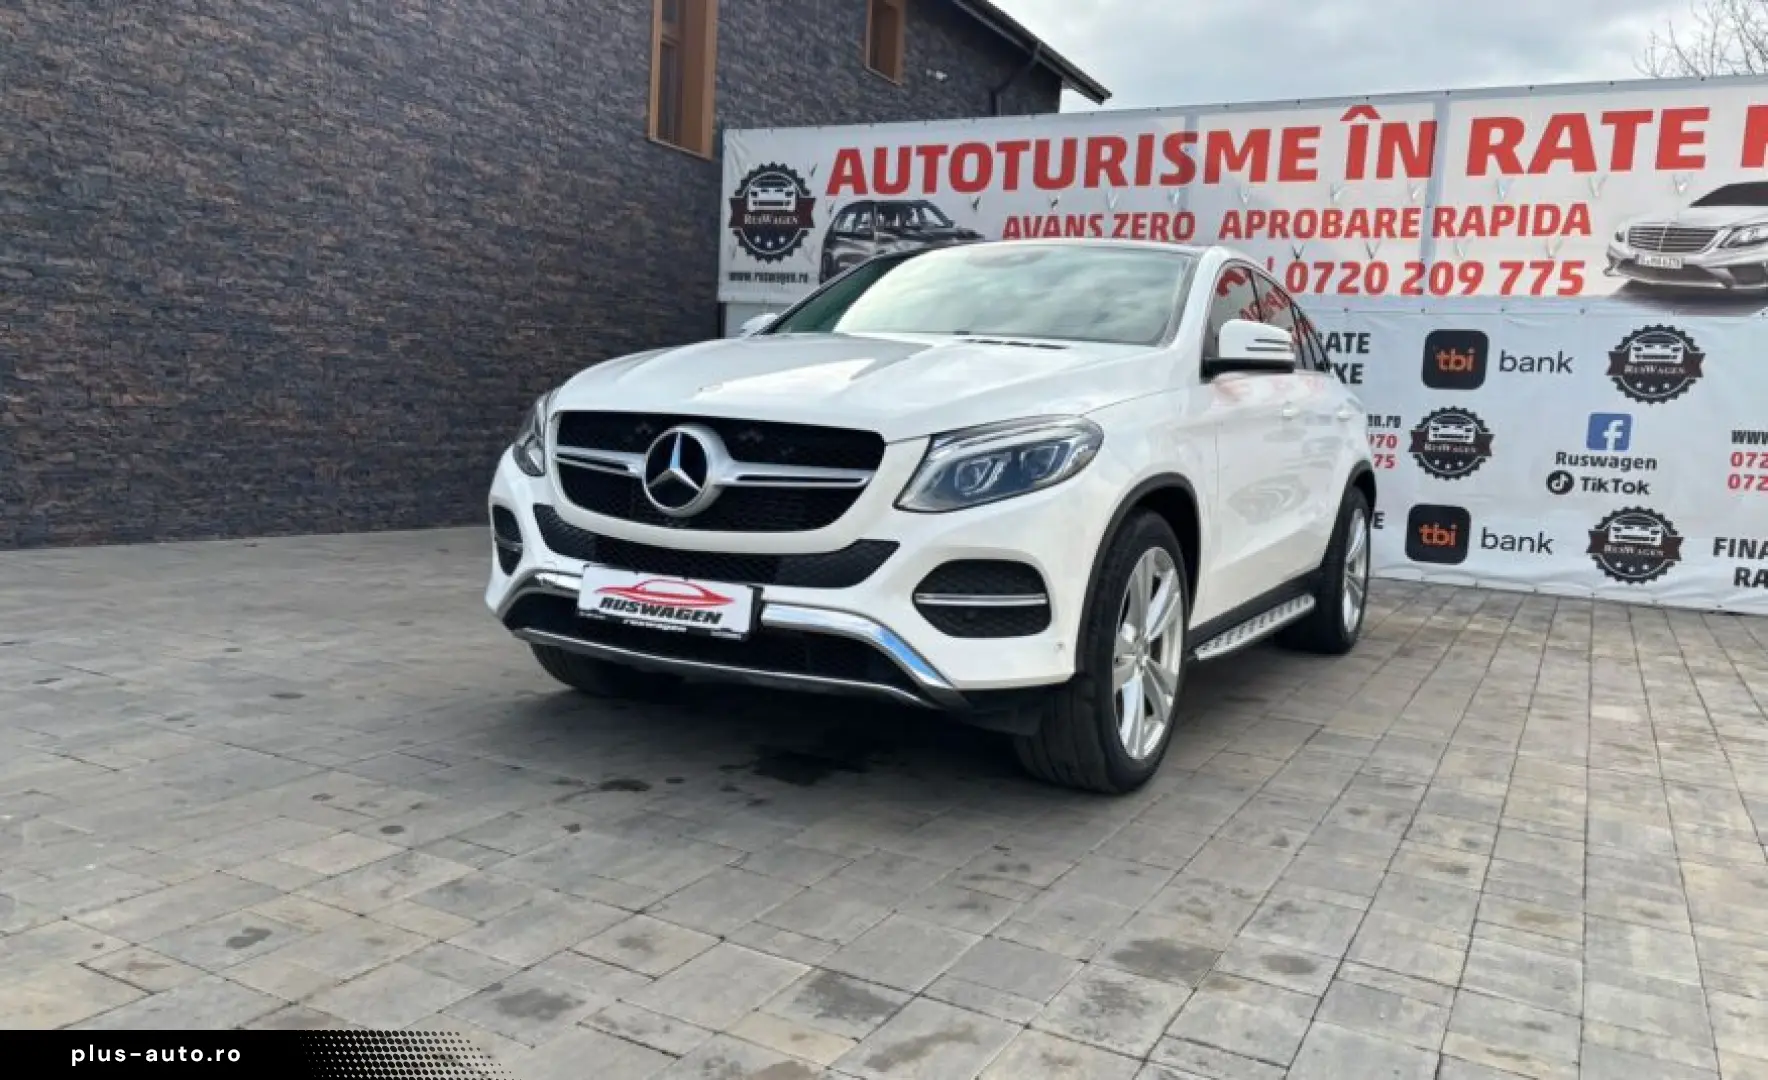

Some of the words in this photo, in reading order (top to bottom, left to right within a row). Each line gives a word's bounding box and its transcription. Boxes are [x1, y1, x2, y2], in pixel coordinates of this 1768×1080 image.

[826, 127, 1320, 195] AUTOTURISME
[1340, 104, 1437, 179] ÎN
[1466, 108, 1710, 177] RATE
[1003, 212, 1104, 240] AVANS
[1111, 210, 1196, 241] ZERO
[1218, 207, 1421, 239] APROBARE
[1432, 203, 1592, 238] RAPIDA
[1285, 261, 1390, 293] 0720
[1400, 262, 1484, 296] 209
[1500, 260, 1586, 296] 775
[1436, 348, 1475, 372] tbi
[1499, 349, 1574, 374] bank
[1556, 451, 1658, 472] Ruswagen
[1580, 476, 1650, 495] TikTok
[1419, 522, 1457, 547] tbi
[1481, 527, 1554, 555] bank
[600, 596, 723, 624] RUSWAGEN
